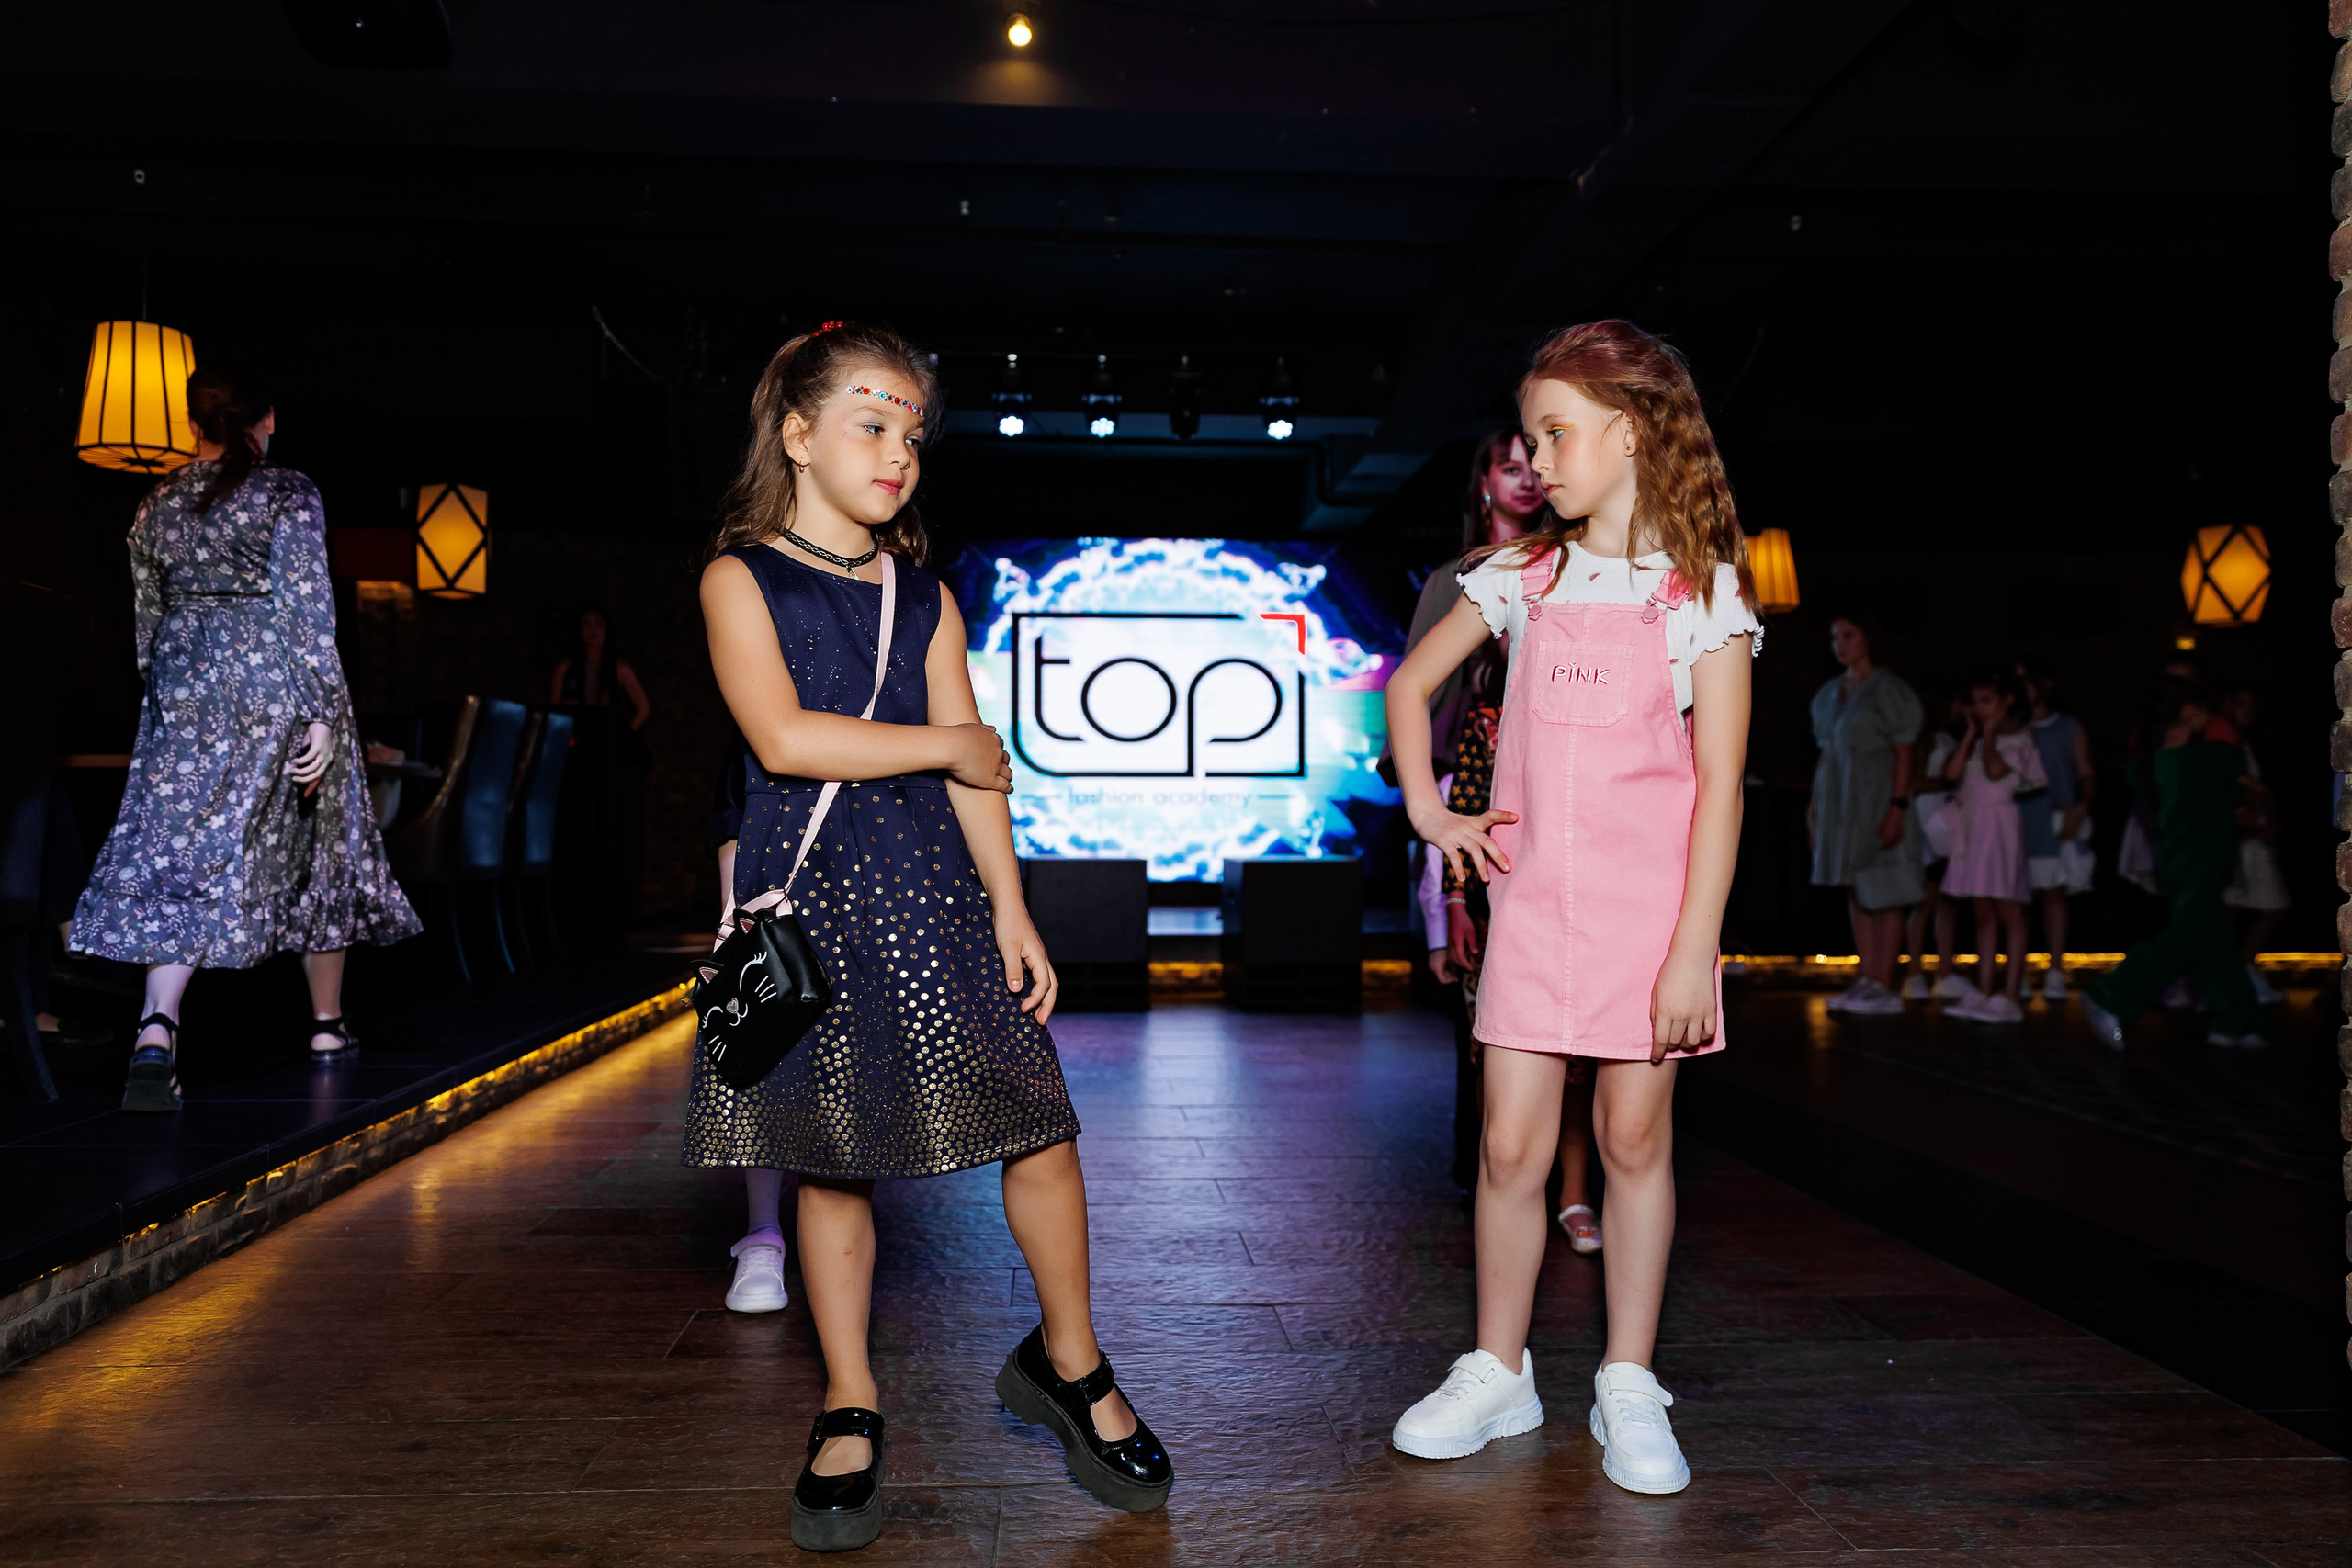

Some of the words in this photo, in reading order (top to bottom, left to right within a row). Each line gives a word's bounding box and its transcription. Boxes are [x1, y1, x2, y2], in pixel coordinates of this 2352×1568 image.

[1551, 662, 1611, 685] PINK
[1035, 636, 1283, 777] top
[1152, 786, 1251, 808] academy
